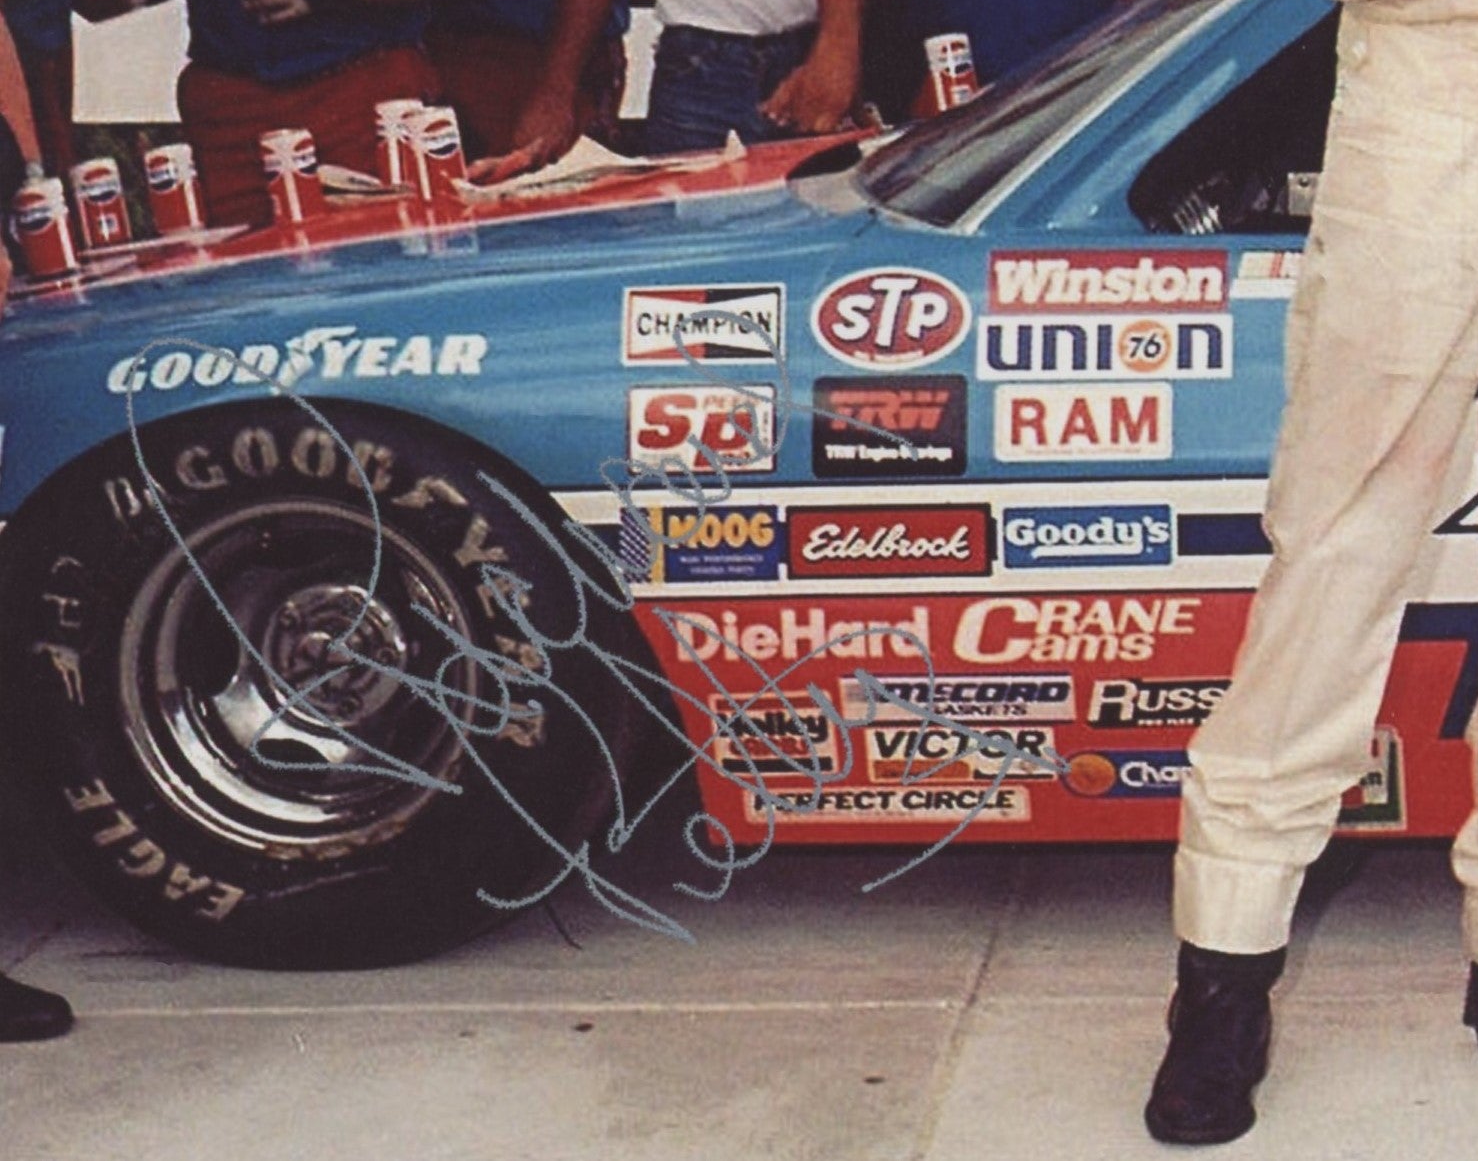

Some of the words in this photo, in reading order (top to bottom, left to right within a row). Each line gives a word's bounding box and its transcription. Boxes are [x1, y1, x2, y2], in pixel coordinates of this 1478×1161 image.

[994, 256, 1224, 305] Winston
[636, 310, 773, 337] CHAMPION
[832, 276, 949, 348] STP
[107, 329, 488, 394] GOODYEAR
[1127, 332, 1162, 360] 76
[829, 390, 950, 431] TRW
[1010, 396, 1160, 447] RAM
[667, 511, 776, 549] MOOG
[801, 521, 971, 561] Edelbrock
[1003, 516, 1170, 558] Goody's
[676, 606, 930, 663] DieHard
[1088, 680, 1226, 722] RUSS
[874, 729, 1048, 759] VICTOR
[901, 790, 1015, 810] CIRCLE
[64, 777, 246, 922] EAGLE
